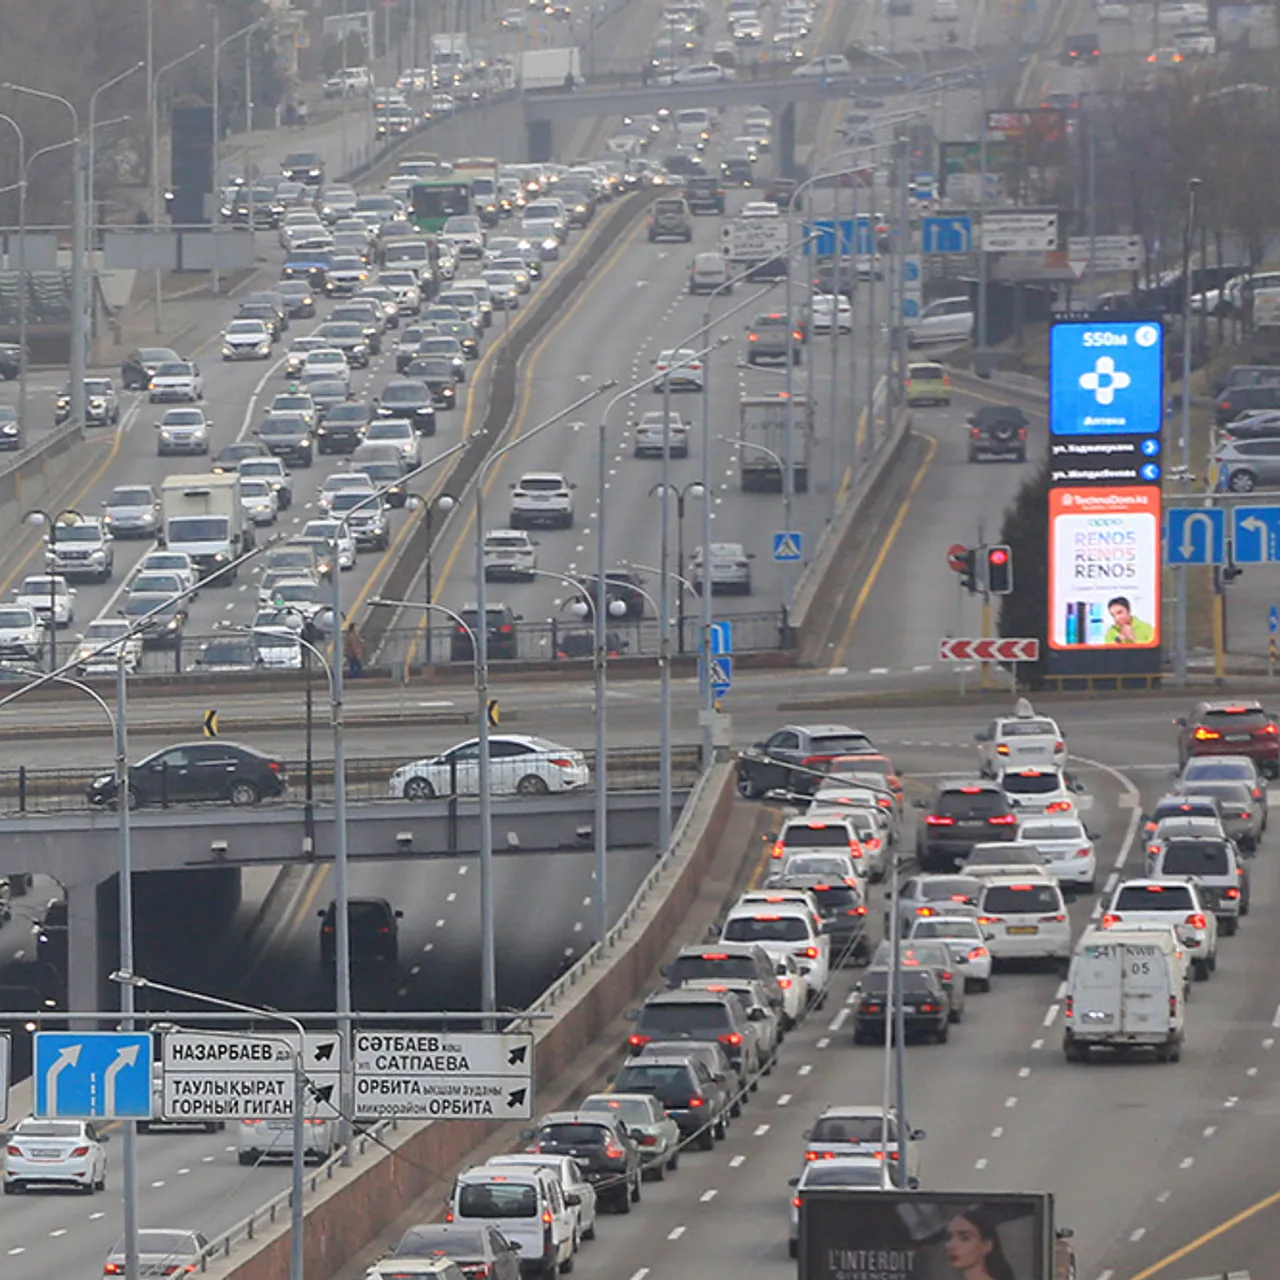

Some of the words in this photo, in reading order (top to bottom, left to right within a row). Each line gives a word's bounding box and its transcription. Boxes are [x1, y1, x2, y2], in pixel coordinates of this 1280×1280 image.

[1074, 531, 1136, 546] RENO5
[1074, 564, 1136, 579] RENO5
[1131, 962, 1151, 975] 05
[358, 1036, 439, 1052] СӘТБАЕВ
[172, 1044, 273, 1061] НАЗАРБАЕВ
[375, 1055, 470, 1071] САТПАЕВА
[358, 1079, 421, 1095] ОРБИТА
[172, 1097, 239, 1115] ГОРНЫЙ
[429, 1100, 493, 1115] ОРБИТА
